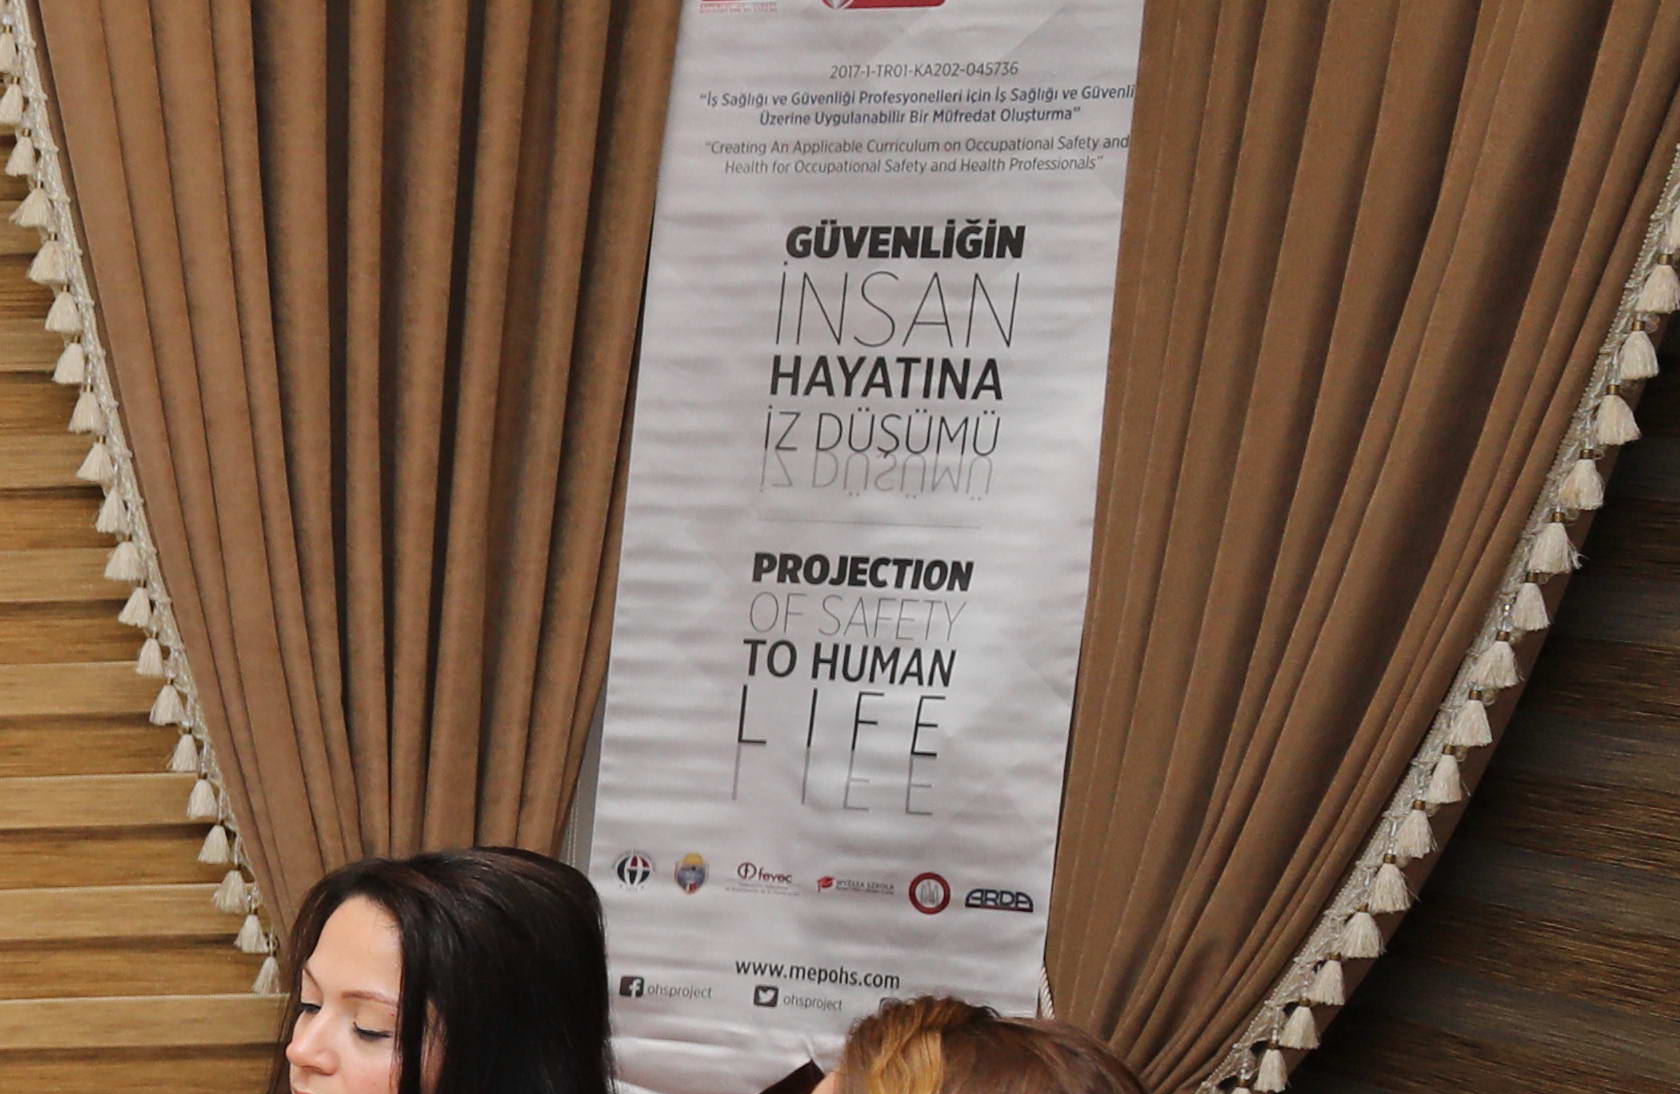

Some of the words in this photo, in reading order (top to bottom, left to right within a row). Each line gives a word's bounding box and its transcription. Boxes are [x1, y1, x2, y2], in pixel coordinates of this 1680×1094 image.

[830, 61, 1019, 80] 2017-1-TR01-KA202-045736
[773, 95, 788, 106] ve
[860, 90, 962, 106] Profesyonelleri
[1062, 88, 1078, 100] ve
[1081, 85, 1135, 99] Güvenli
[815, 110, 905, 127] Uygulanabilir
[910, 110, 929, 123] Bir
[932, 108, 996, 123] Müfredat
[770, 140, 789, 154] An
[792, 139, 862, 156] Applicable
[867, 138, 940, 153] Curriculum
[944, 141, 961, 152] on
[965, 137, 1054, 153] Occupational
[1057, 135, 1099, 152] Safety
[1103, 135, 1130, 148] and
[725, 160, 768, 174] Health
[772, 160, 791, 173] for
[794, 159, 881, 175] Occupational
[884, 158, 927, 174] Safety
[930, 158, 957, 172] and
[960, 157, 1005, 172] Health
[786, 219, 1026, 259] GÜVENLİĞİN
[775, 261, 1021, 349] İNSAN
[769, 355, 1004, 401] HAYATINA
[764, 405, 801, 453] İZ
[815, 407, 1002, 459] DÜŞÜMÜ
[751, 551, 974, 592] PROJECTION
[749, 591, 806, 633] OF
[817, 594, 968, 642] SAFETY
[742, 638, 798, 679] TO
[811, 642, 957, 688] HUMAN
[737, 684, 947, 757] LIFE
[647, 982, 713, 1000] ohsproject
[735, 960, 901, 990] www.mepohs.com
[783, 993, 842, 1012] ohsproject
